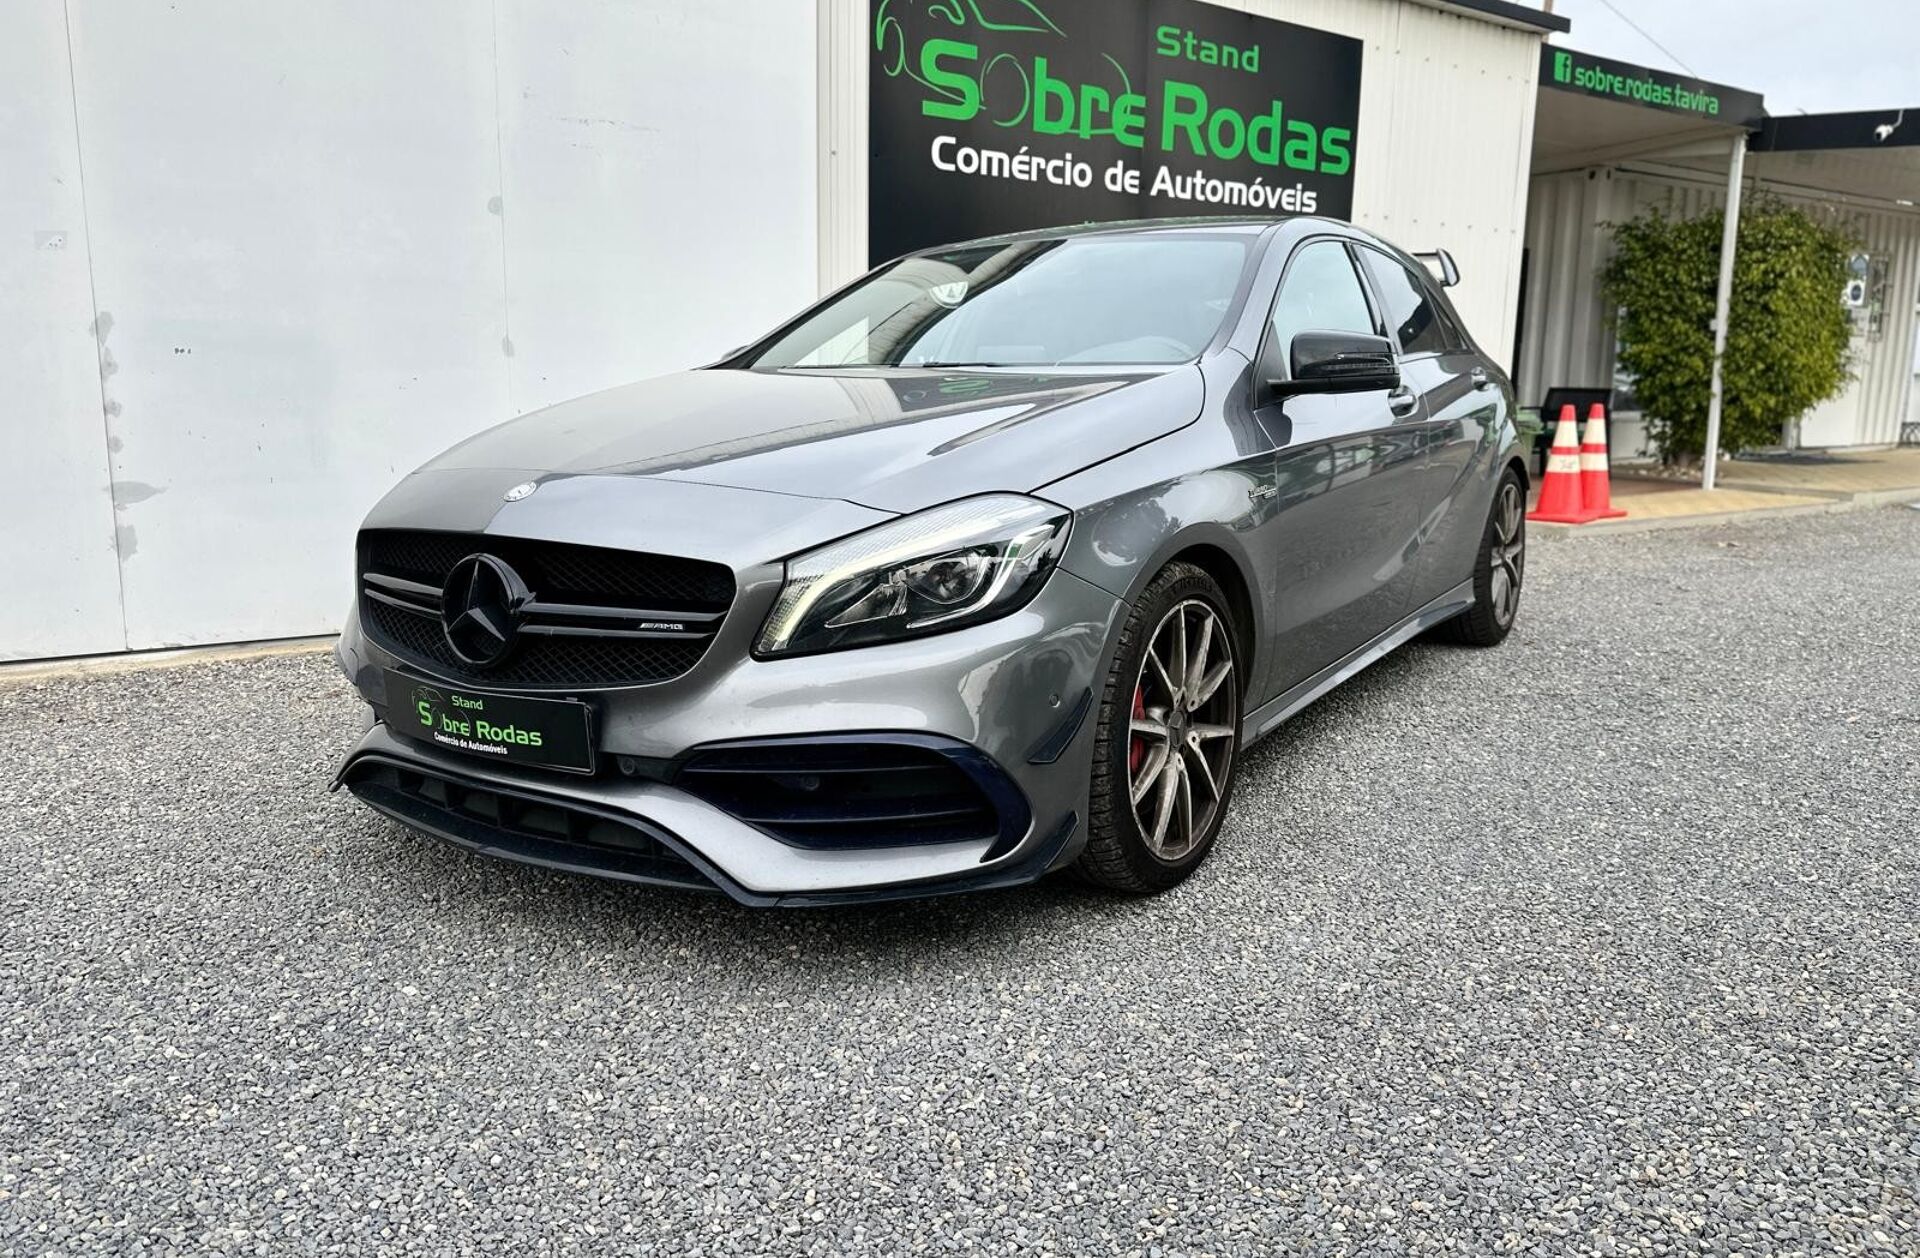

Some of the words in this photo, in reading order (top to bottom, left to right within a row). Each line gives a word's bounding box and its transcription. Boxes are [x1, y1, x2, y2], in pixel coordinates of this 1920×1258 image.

[1156, 25, 1259, 73] Stand
[1575, 66, 1719, 114] sobre.rodas.tavira
[1161, 80, 1351, 175] Rodas
[931, 136, 1093, 188] Comércio
[1104, 161, 1140, 194] de
[1151, 167, 1317, 213] Automóveis
[451, 695, 483, 710] Stand
[460, 739, 467, 748] de
[475, 720, 542, 746] Rodas
